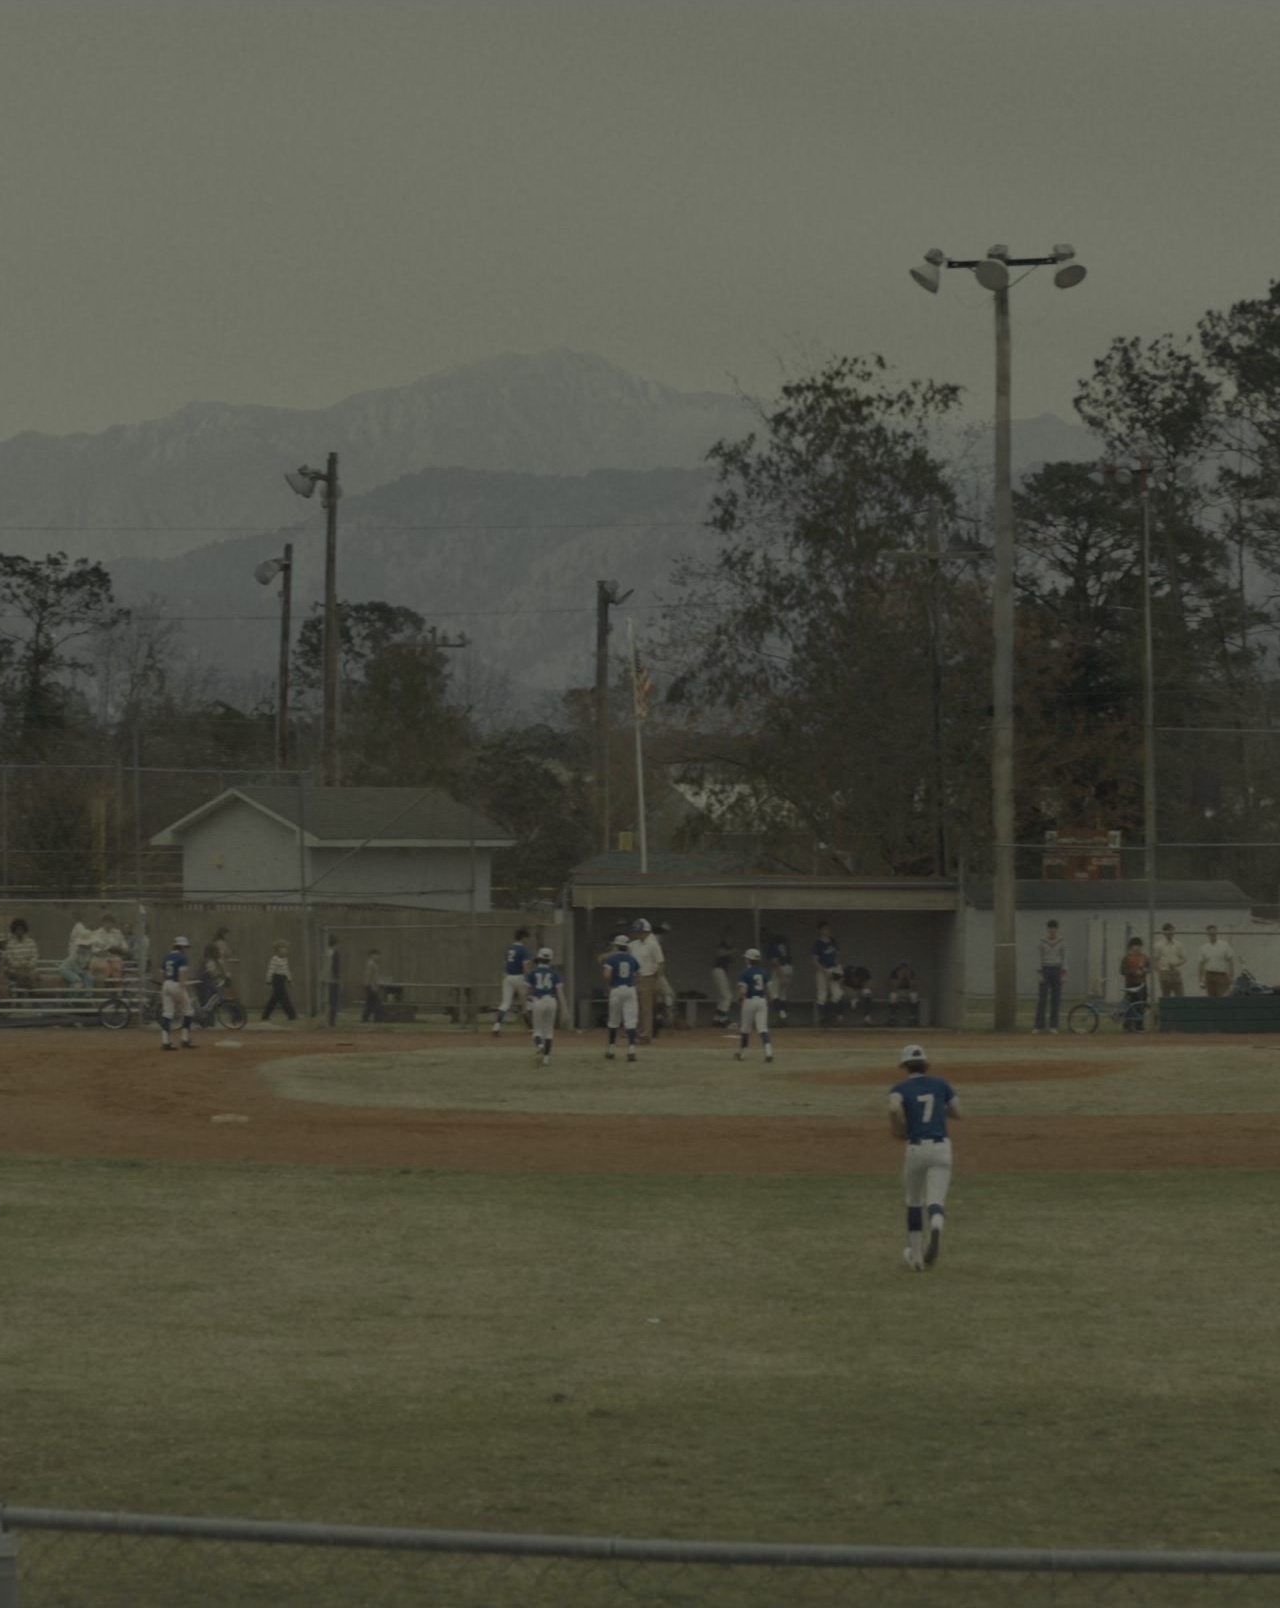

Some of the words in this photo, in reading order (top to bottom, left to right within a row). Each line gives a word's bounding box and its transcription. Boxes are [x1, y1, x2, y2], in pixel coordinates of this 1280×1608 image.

[165, 960, 175, 977] 5
[535, 972, 552, 989] 14
[752, 974, 763, 991] 3
[916, 1093, 935, 1123] 7
